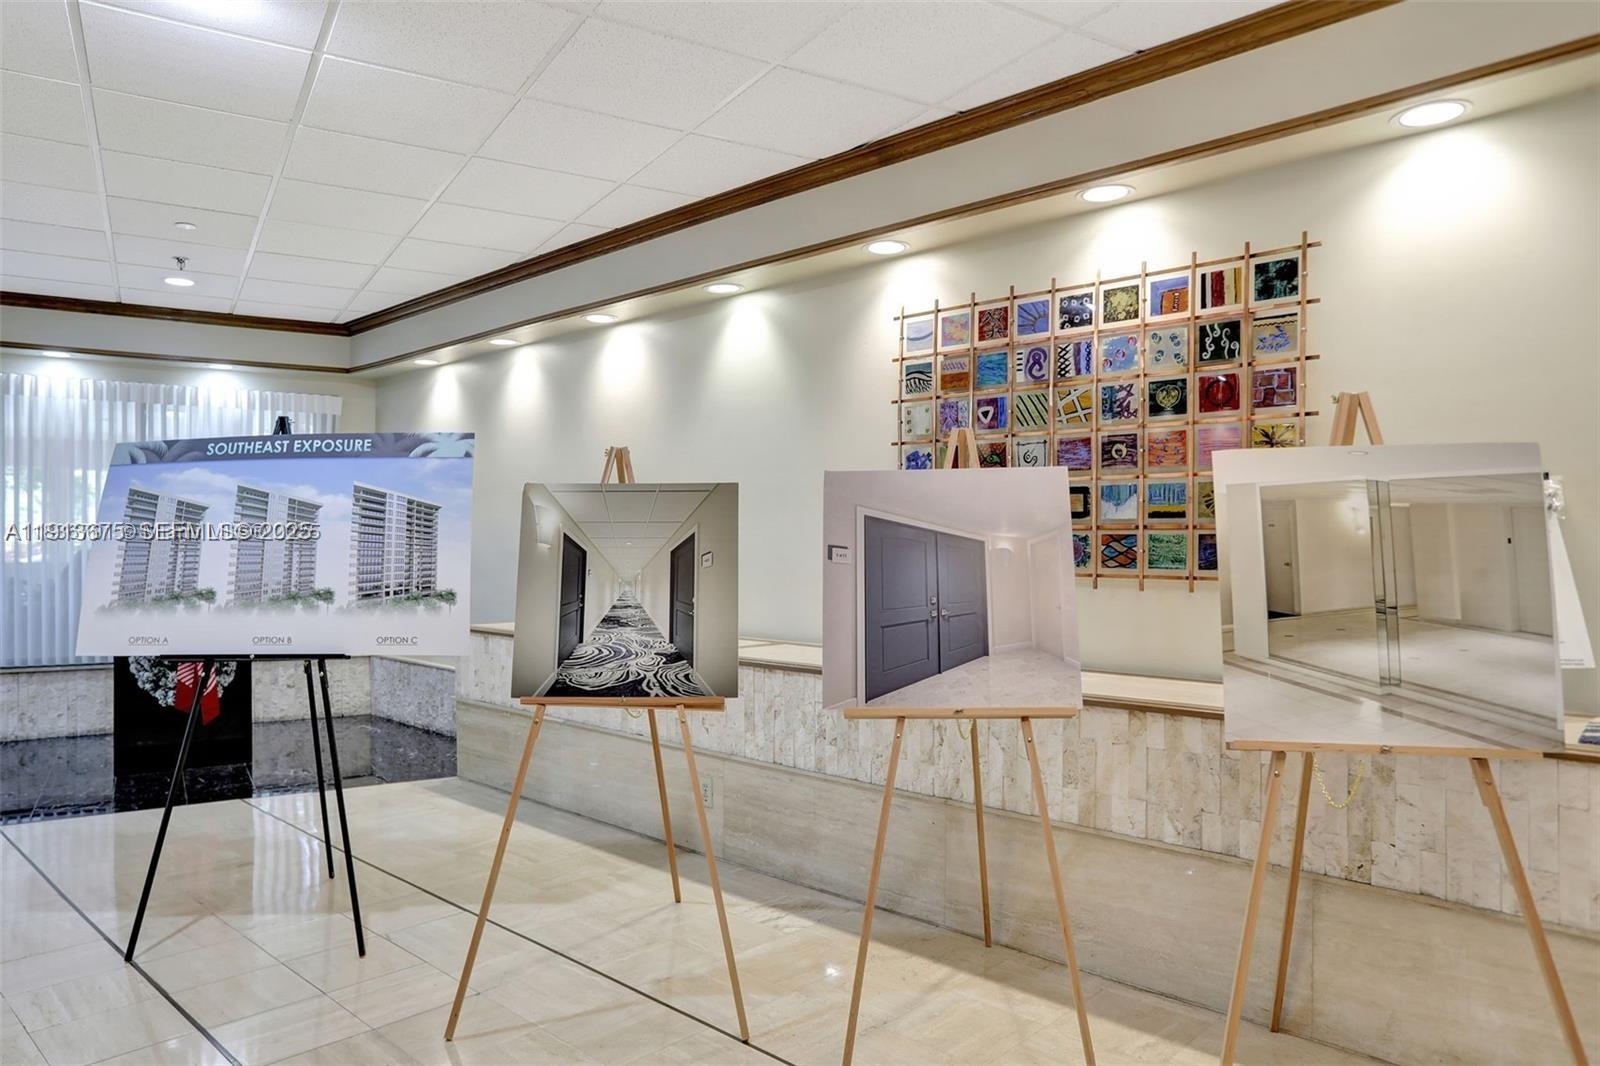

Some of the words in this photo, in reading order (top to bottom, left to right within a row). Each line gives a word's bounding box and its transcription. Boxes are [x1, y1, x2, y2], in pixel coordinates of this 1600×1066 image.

[206, 440, 290, 456] SOUTHEAST
[293, 438, 373, 453] EXPOSURE
[128, 636, 161, 644] OPTION
[162, 636, 169, 644] A
[252, 636, 285, 644] OPTION
[286, 636, 293, 644] B
[376, 636, 409, 644] OPTION
[410, 636, 418, 644] C
